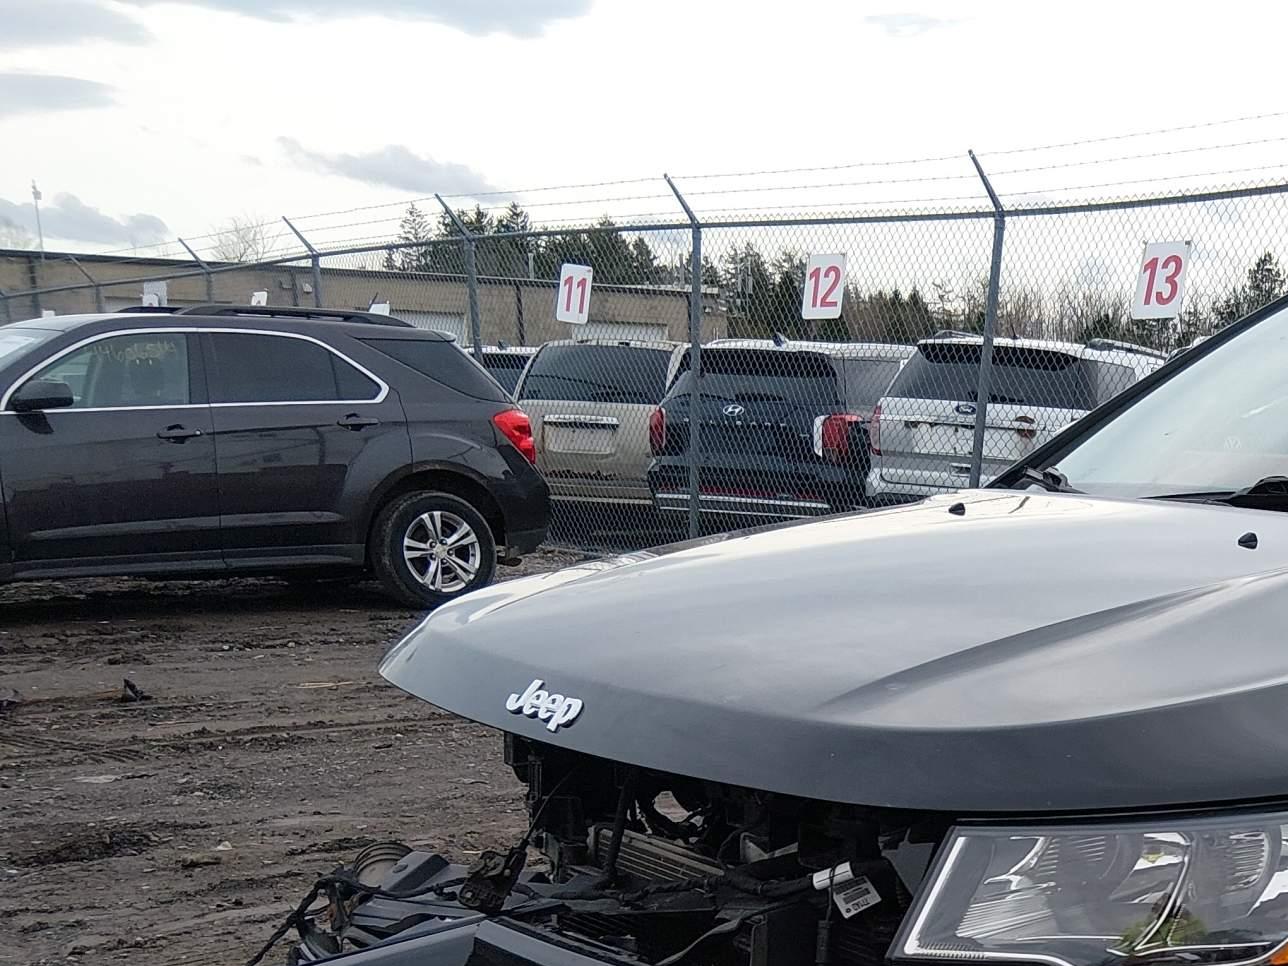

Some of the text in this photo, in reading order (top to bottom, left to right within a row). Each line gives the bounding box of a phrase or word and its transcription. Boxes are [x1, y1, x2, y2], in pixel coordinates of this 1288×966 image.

[563, 275, 588, 314] 11
[809, 265, 841, 308] 12
[1143, 254, 1183, 306] 13
[505, 678, 584, 733] Jeep
